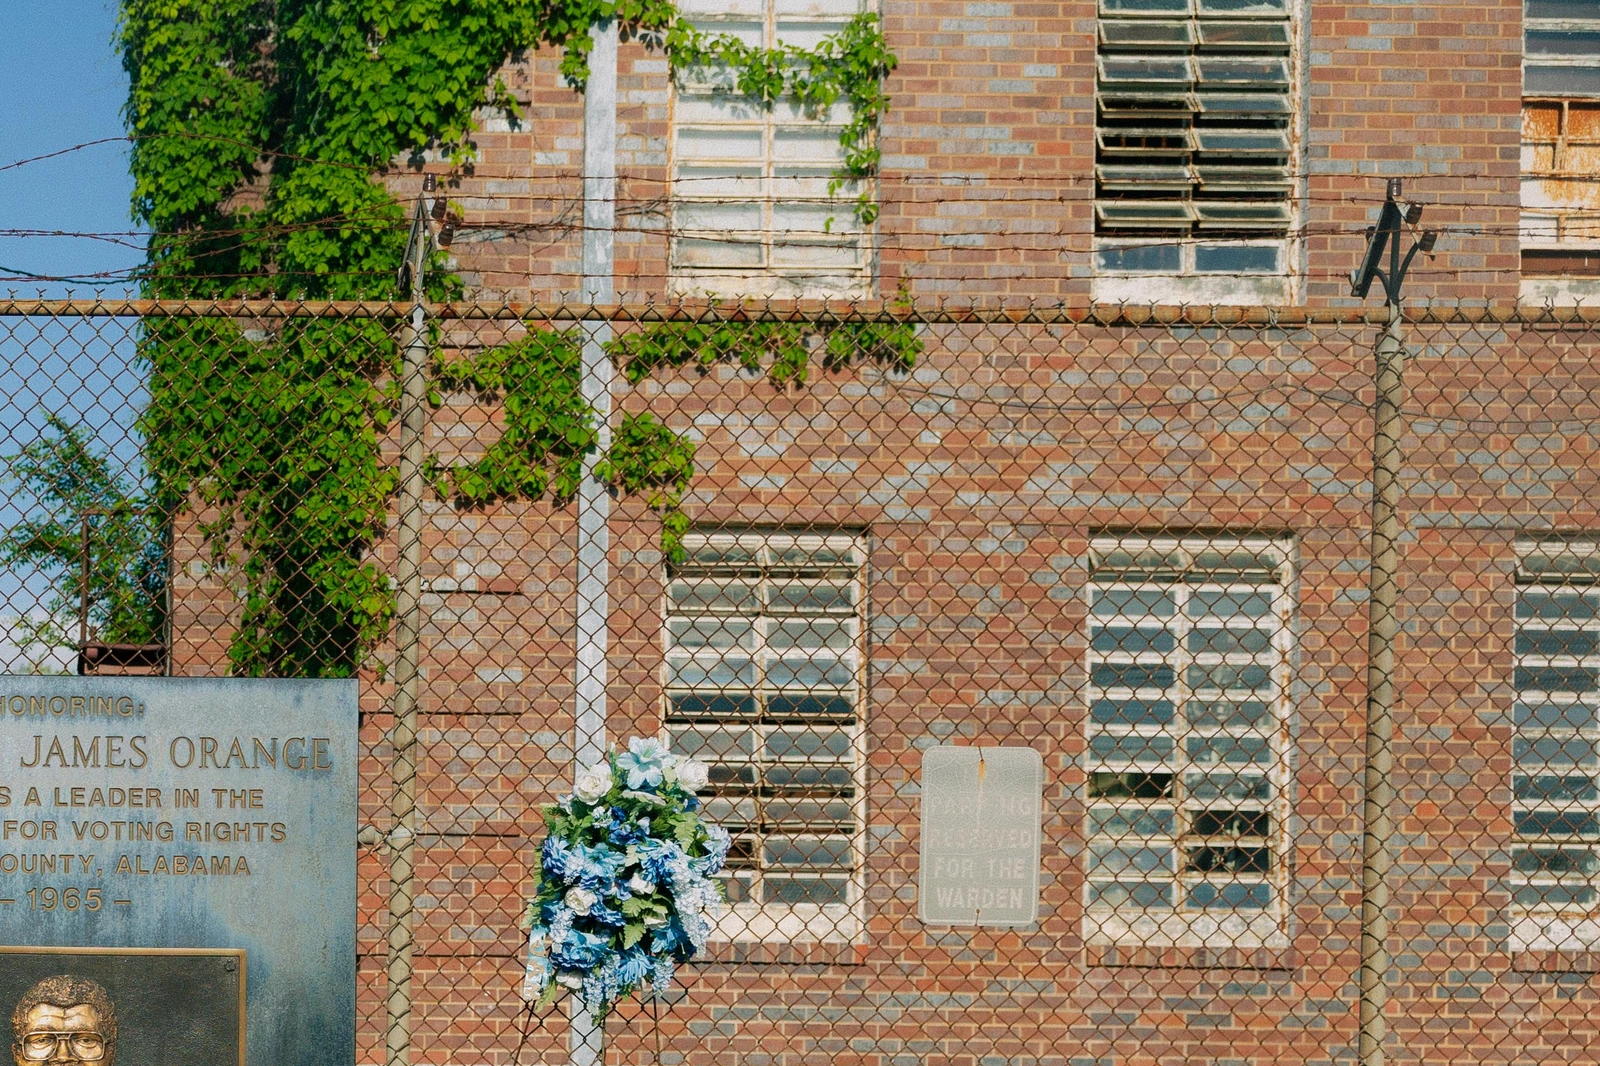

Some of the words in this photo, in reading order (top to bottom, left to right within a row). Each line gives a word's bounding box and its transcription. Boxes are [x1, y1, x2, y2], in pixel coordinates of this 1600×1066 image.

[20, 735, 148, 769] JAMES
[170, 737, 333, 771] ORANGE
[25, 788, 41, 807] A
[54, 787, 161, 808] LEADER
[175, 789, 199, 808] IN
[212, 789, 264, 809] THE
[931, 797, 1030, 815] PARKNG
[4, 820, 56, 840] FOR
[71, 821, 173, 842] VOTING
[186, 823, 287, 843] RIGHTS
[116, 855, 251, 875] ALABAMA
[934, 857, 973, 878] FOR
[986, 858, 1026, 878] THE
[26, 888, 102, 911] 1965
[936, 887, 1023, 909] WARDEN
